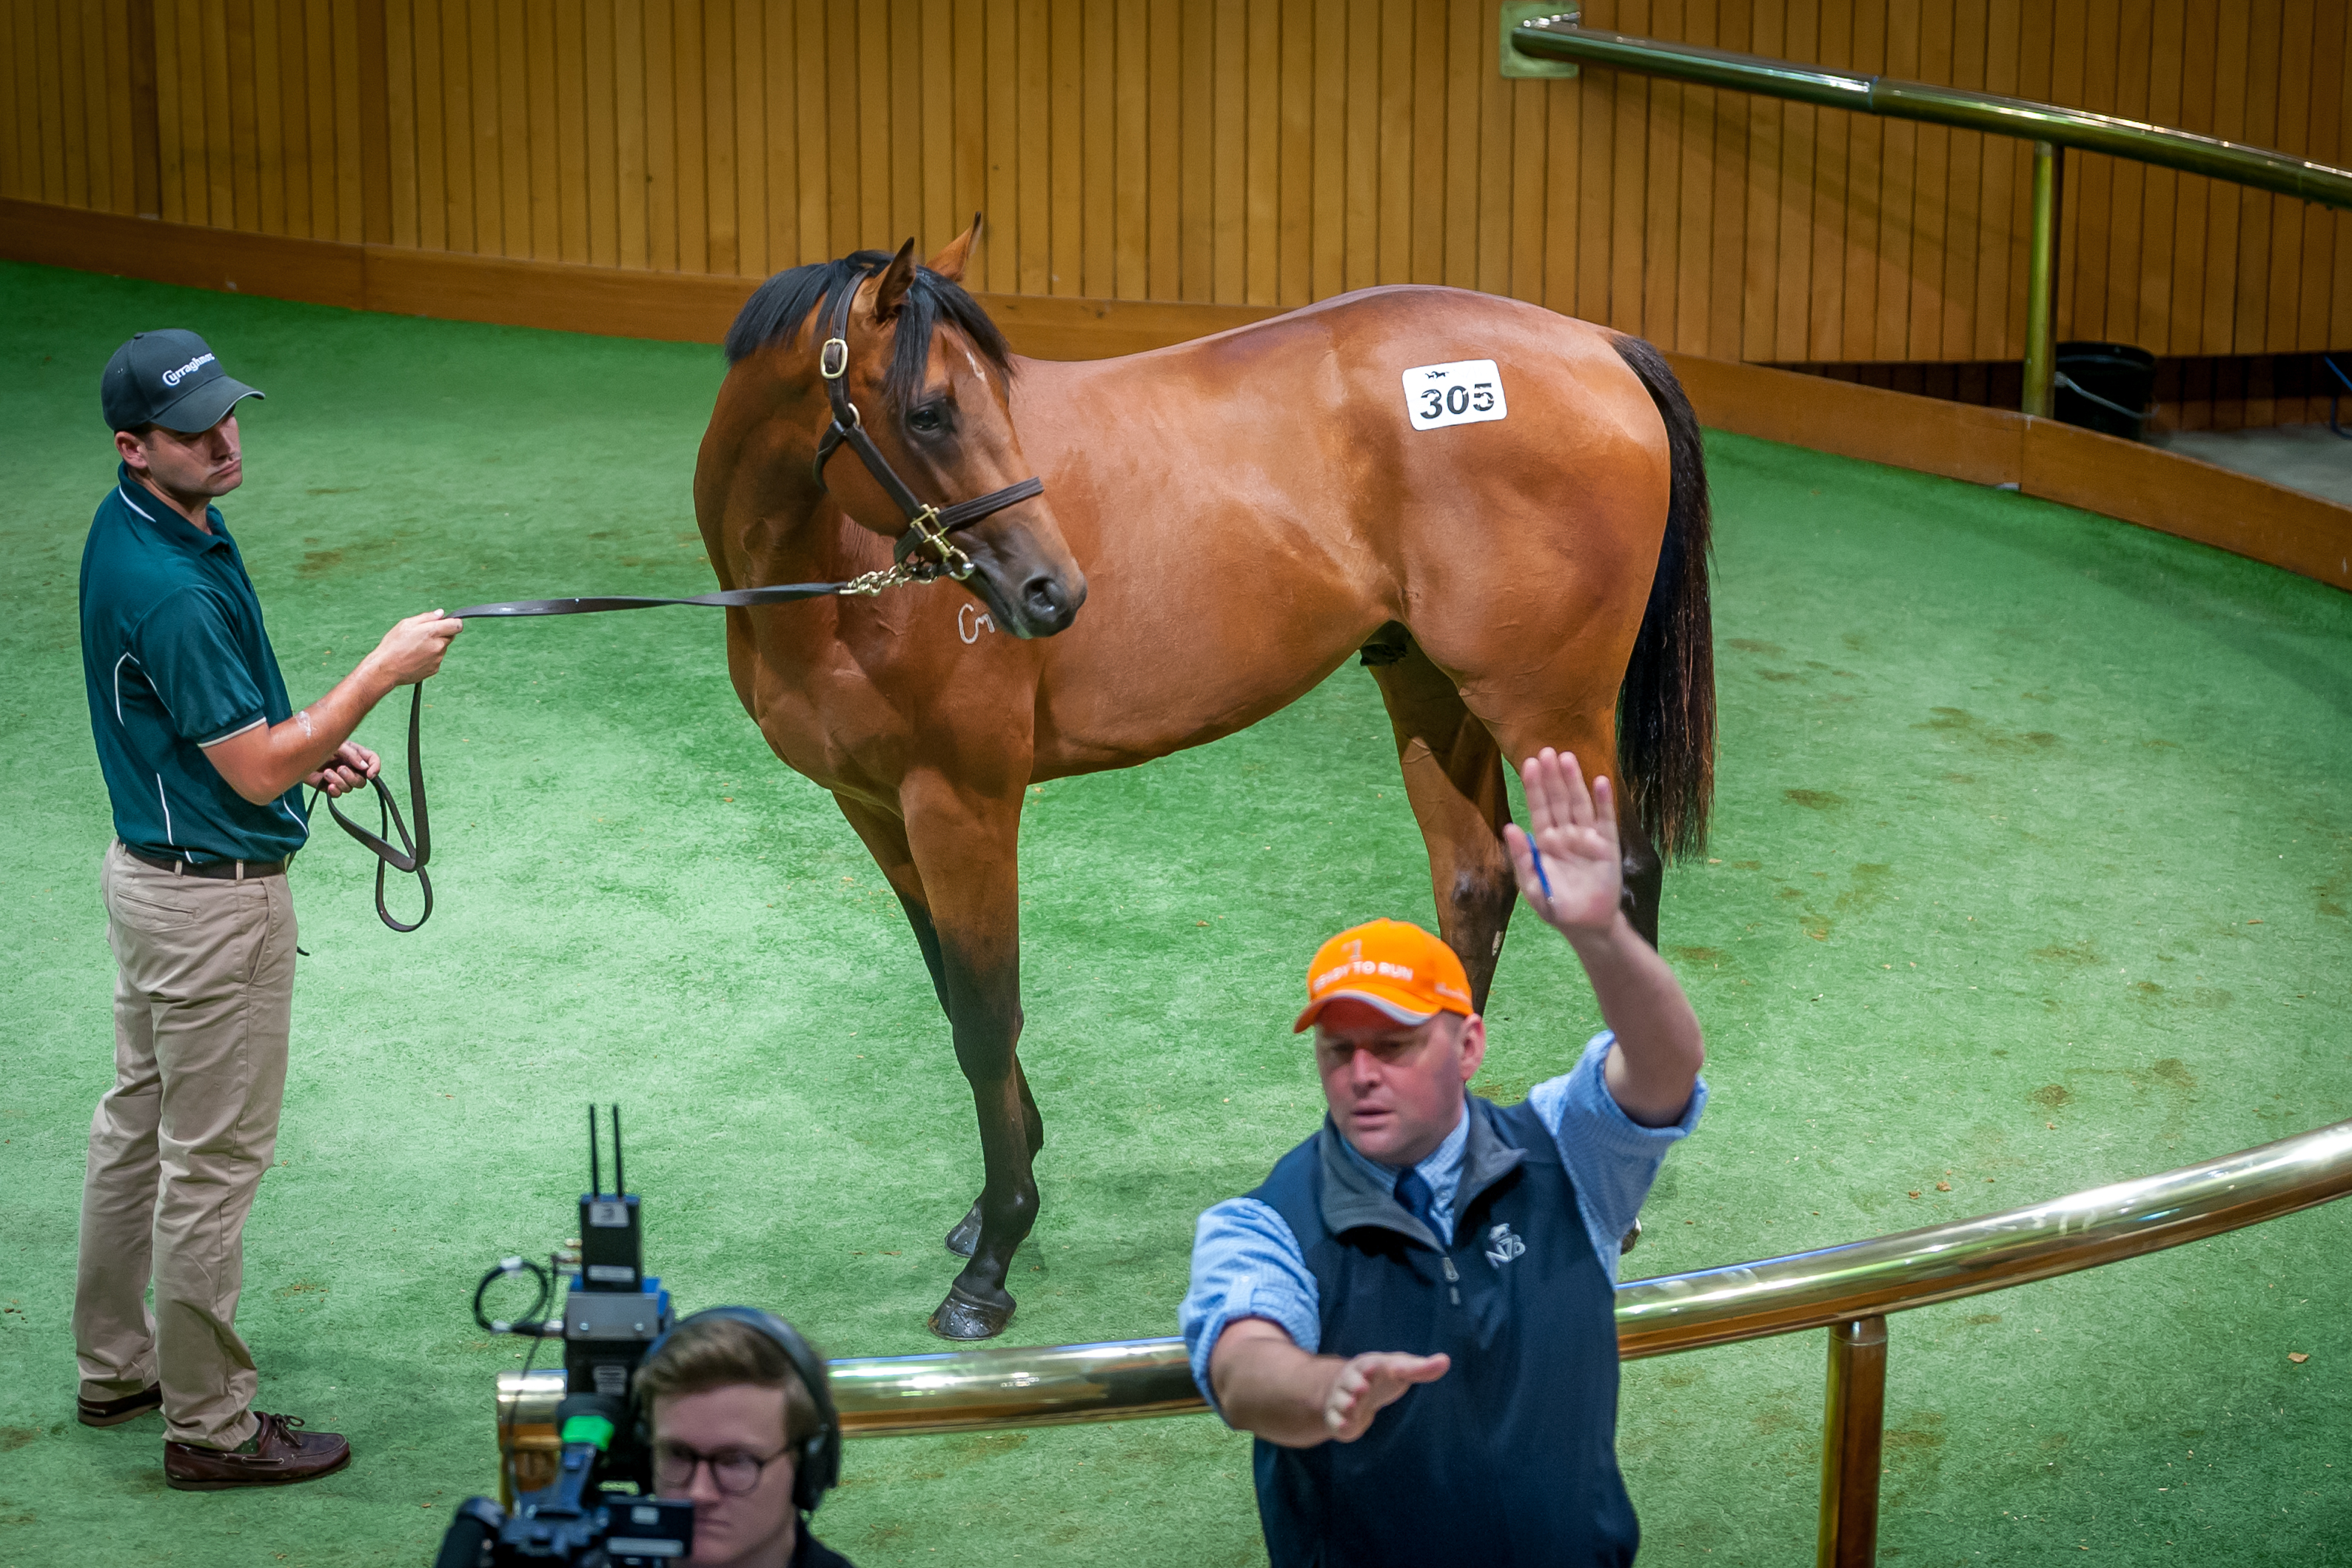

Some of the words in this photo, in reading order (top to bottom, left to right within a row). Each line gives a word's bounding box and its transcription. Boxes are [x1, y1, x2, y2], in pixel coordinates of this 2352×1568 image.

[1420, 382, 1495, 420] 305
[1353, 960, 1376, 975] TO
[1378, 962, 1414, 982] RUN
